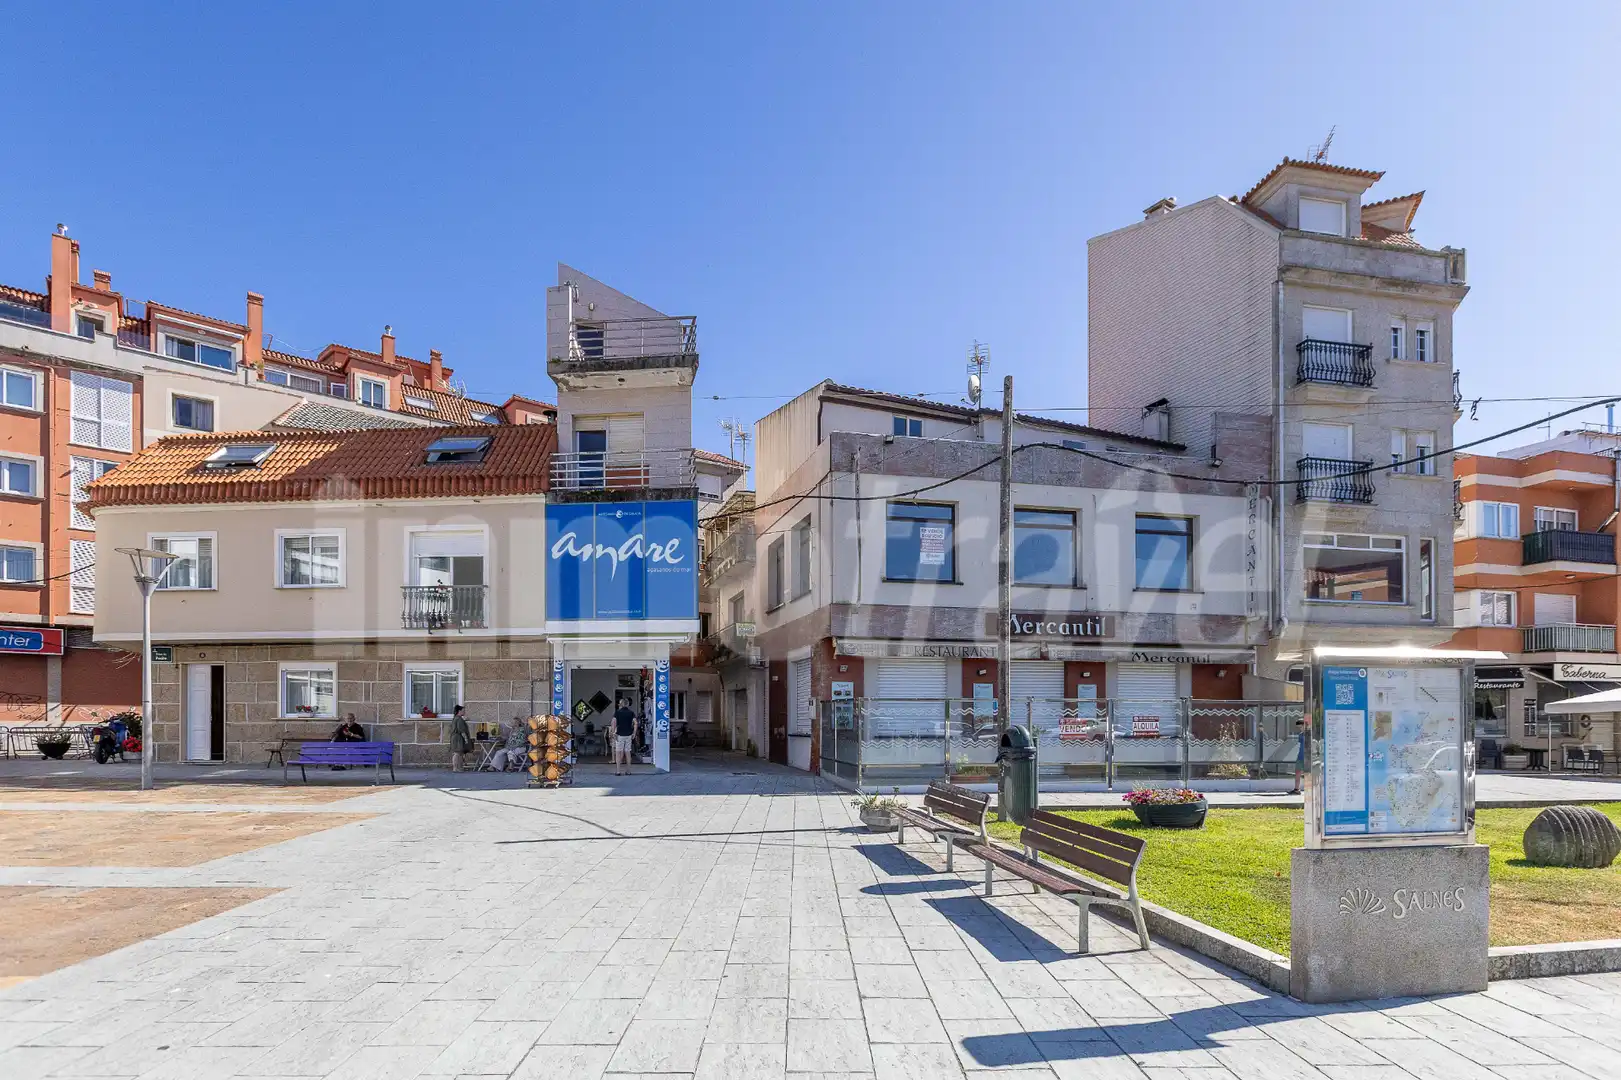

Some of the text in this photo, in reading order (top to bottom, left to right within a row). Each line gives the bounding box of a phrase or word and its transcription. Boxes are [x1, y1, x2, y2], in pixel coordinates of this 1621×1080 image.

[551, 531, 685, 582] amare
[1560, 663, 1607, 679] Taberna
[1133, 722, 1159, 730] ALQUILA
